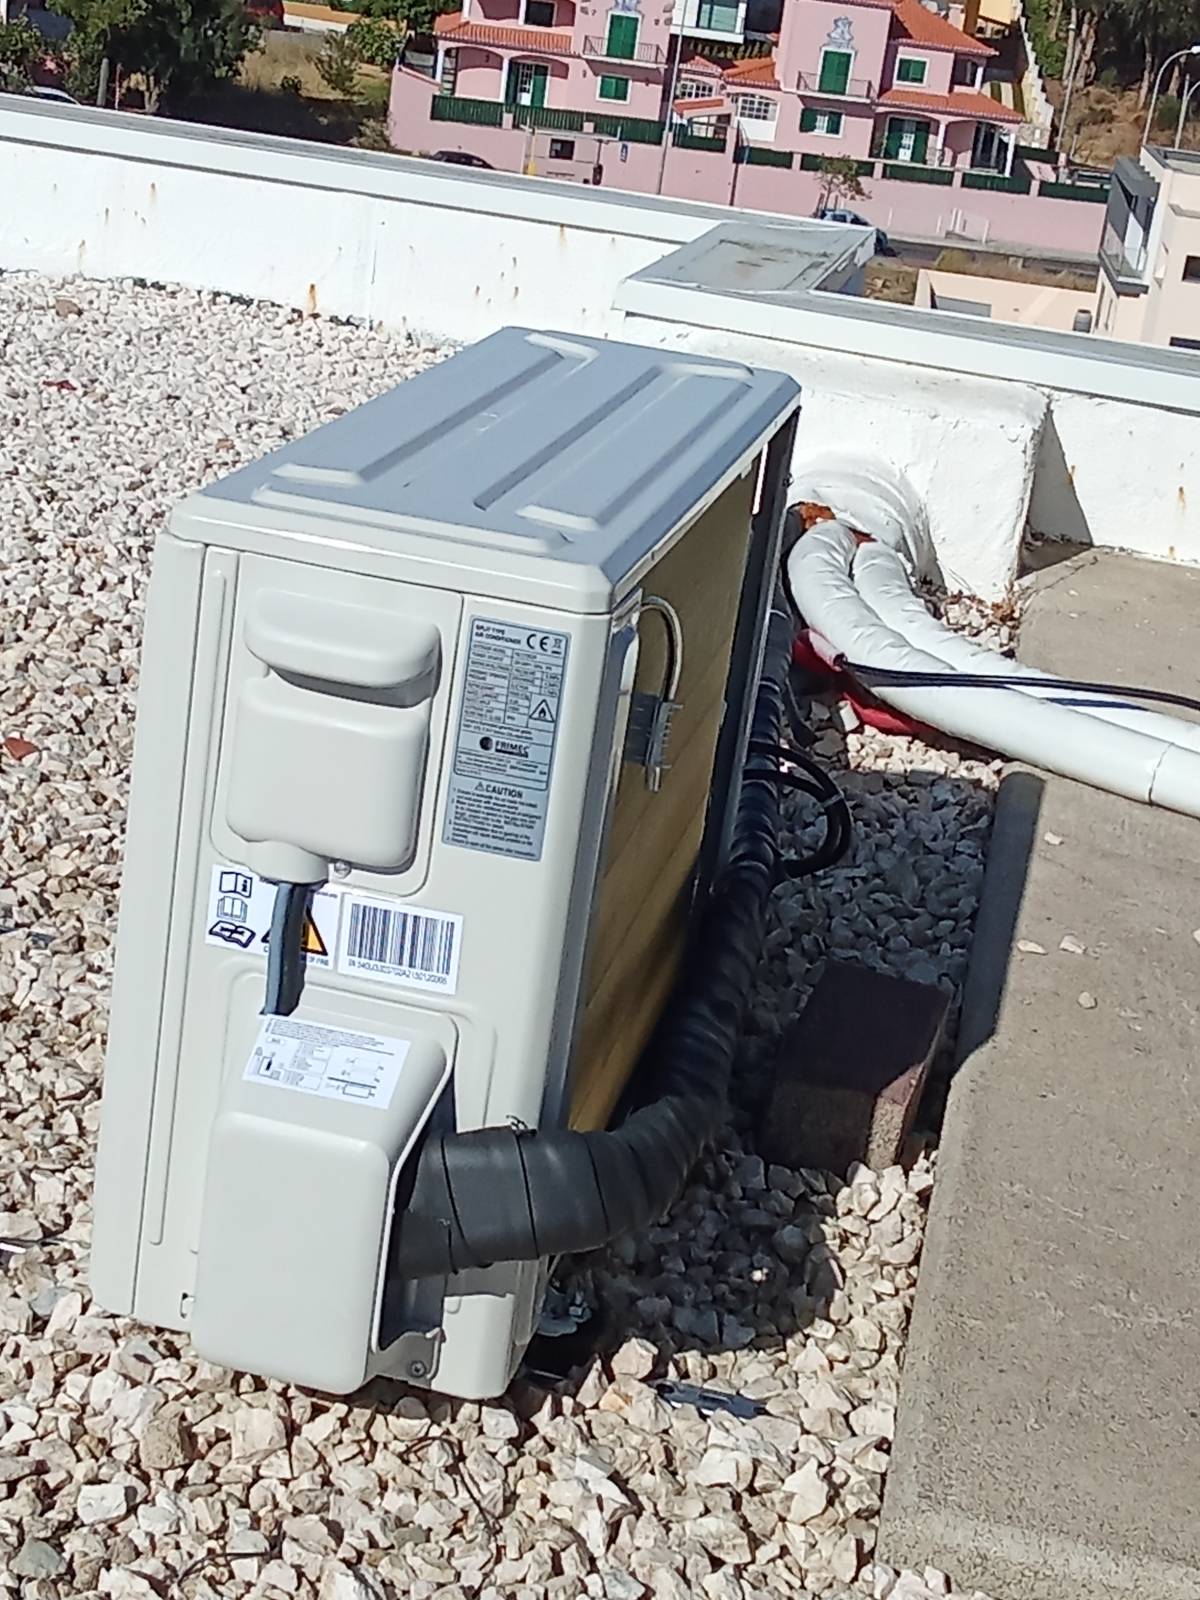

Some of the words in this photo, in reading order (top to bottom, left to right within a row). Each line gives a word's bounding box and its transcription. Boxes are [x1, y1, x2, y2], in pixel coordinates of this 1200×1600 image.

[485, 633, 521, 644] CONDITIONER
[526, 633, 549, 652] CE
[485, 784, 523, 798] CAUTION
